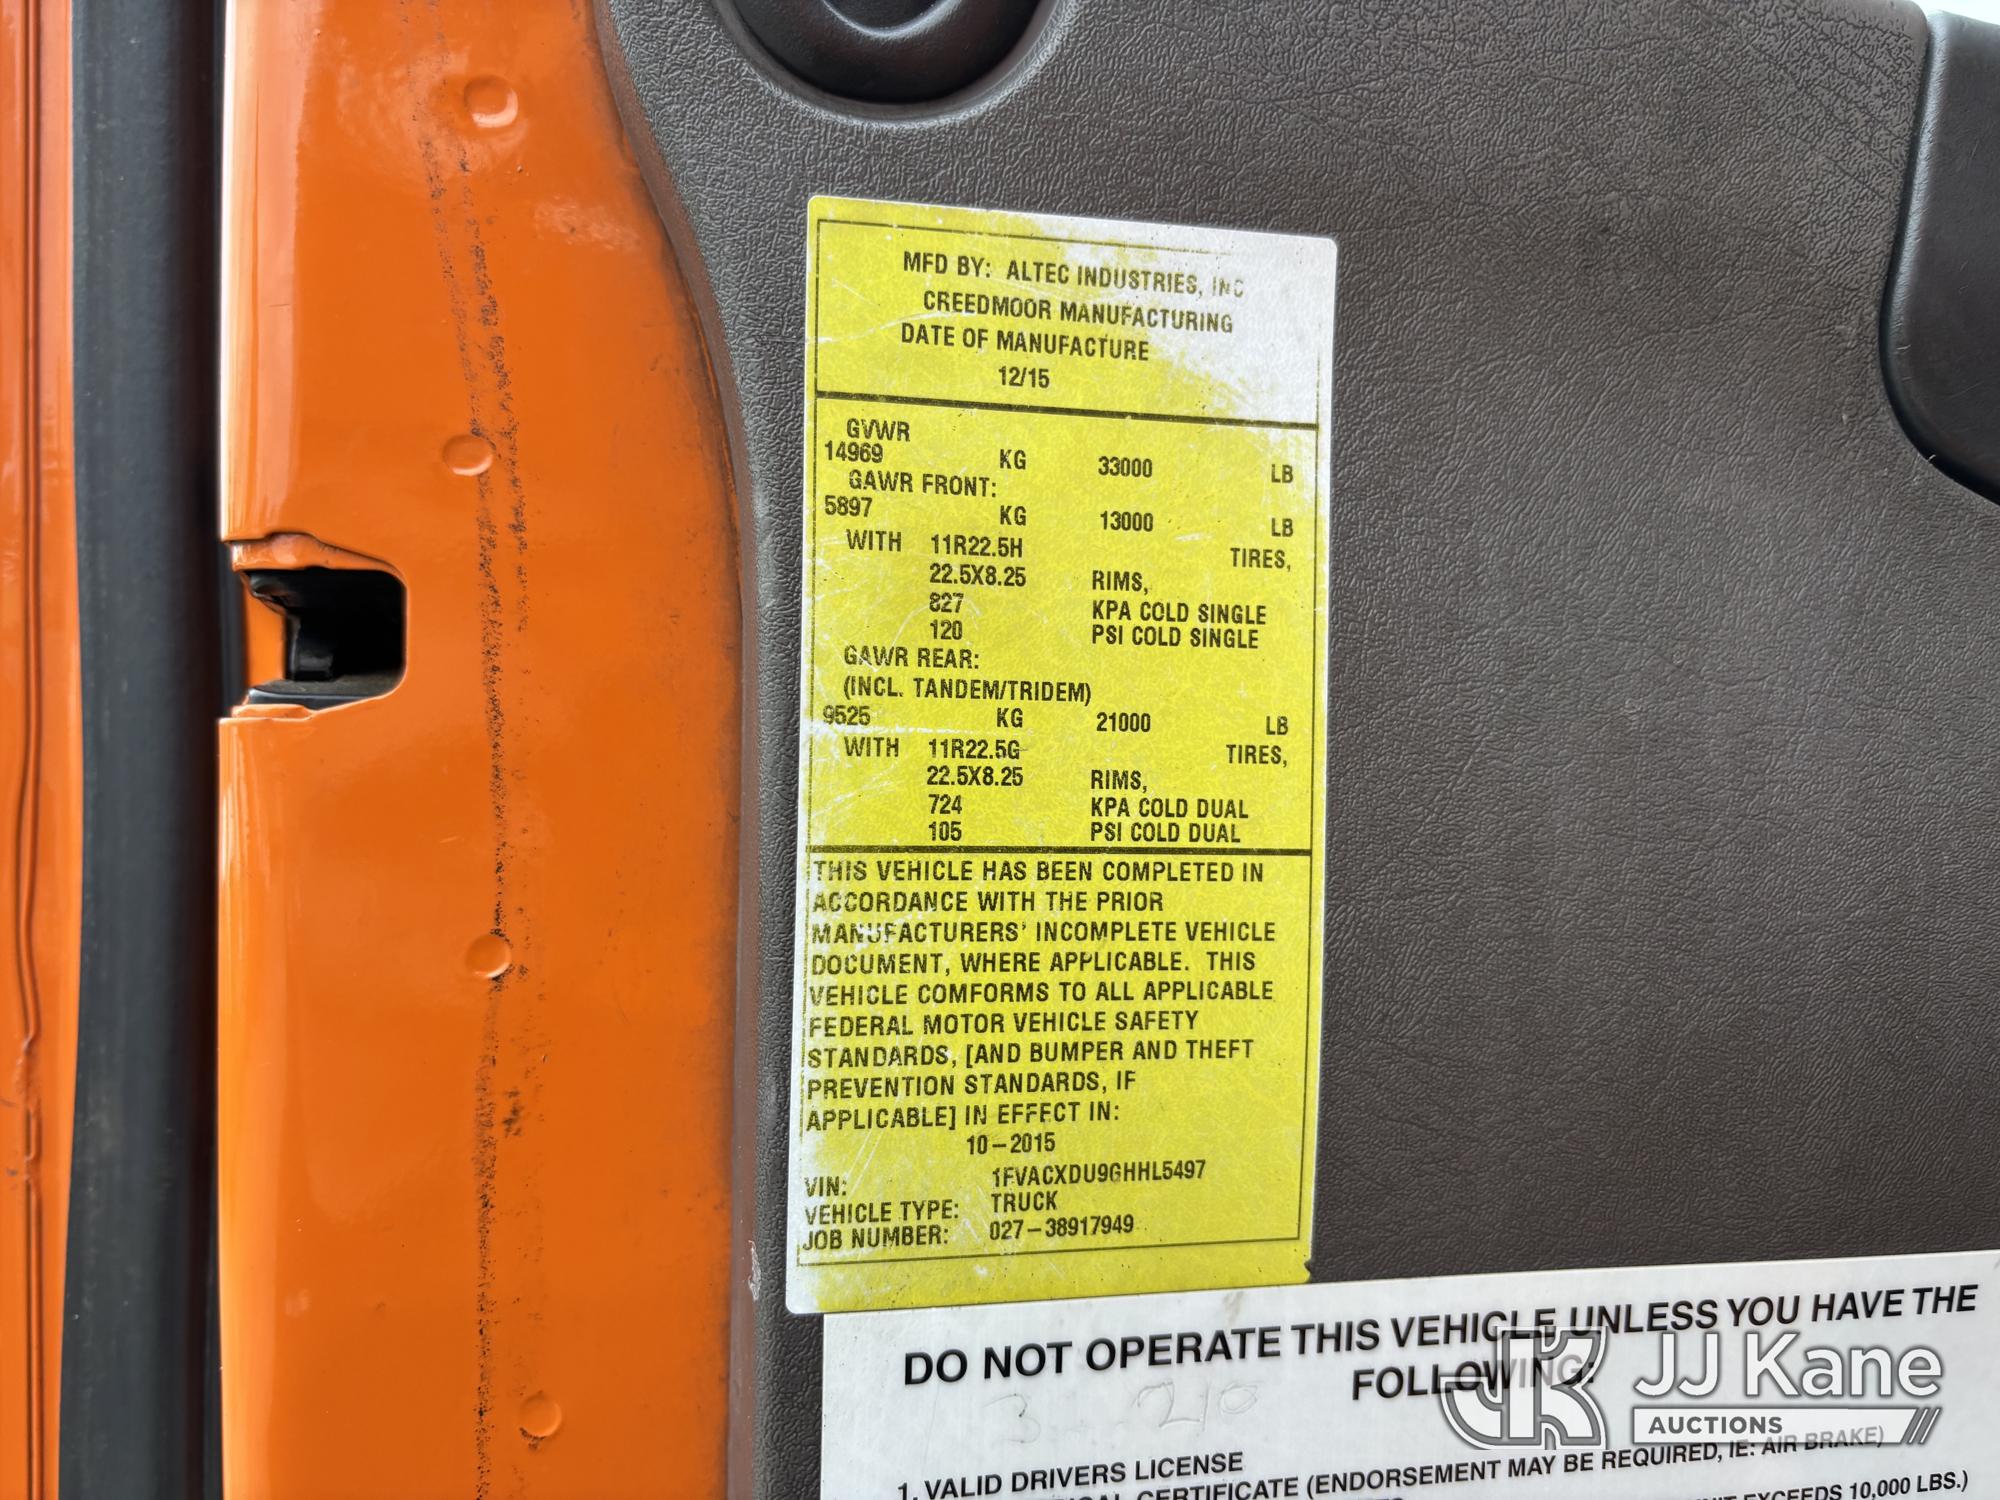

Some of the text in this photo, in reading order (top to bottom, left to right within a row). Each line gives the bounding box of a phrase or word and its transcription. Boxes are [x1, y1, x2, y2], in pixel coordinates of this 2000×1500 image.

[904, 251, 947, 274] MFD
[958, 256, 990, 278] BY:
[1007, 260, 1069, 284] ALTEC
[1078, 266, 1202, 296] INDUSTRIES,
[924, 290, 1232, 333] CREEDMOOR MANUFACTURING
[902, 322, 1148, 361] DATE OF MANUFACTURE
[999, 366, 1049, 388] 12/15
[847, 418, 910, 442] GVWR
[825, 440, 1293, 483] 14969 KG 33000 LB
[849, 469, 996, 497] GAWR FRONT:
[825, 495, 1293, 537] 5897 KG 13000 LB
[846, 529, 1290, 572] WITH 11R22.5H TIRES,
[930, 563, 1148, 595] 22.5X8.25 RIMS,
[929, 592, 1266, 625] 827 KPA COLD SINGLE
[930, 619, 1258, 649] 120 PSI COLD SINGLE
[844, 645, 979, 669] GAWR REAR:
[844, 676, 1091, 706] (INCL. TANDEM/TRIDEM)
[823, 705, 1288, 735] 9525 KG 21000 LB
[844, 736, 1287, 768] WITH 11R22.5G TIRES,
[927, 765, 1147, 793] 22.5X8.25 RIMS,
[928, 794, 1248, 818] 724 KPA COLD DUAL
[929, 821, 1240, 843] 105 PSI COLD DUAL
[814, 860, 1263, 882] THIS VEHICLE HAS BEEN COMPLETED IN
[813, 891, 1163, 912] ACCORDANCE WITH THE PRIOR
[1037, 921, 1176, 941] INCOMPLETE
[1185, 922, 1275, 941] VEHICLE
[812, 951, 1255, 976] DOCUMENT, WHERE APPLICABLE. THIS
[810, 981, 1273, 1006] VEHICLE COMFORMS TO ALL APPLICABLE
[810, 1010, 1198, 1037] FEDERAL MOTOR VEHICLE SAFETY
[808, 1039, 1254, 1068] STANDARDS, [AND BUMPER AND THEFT
[808, 1070, 1135, 1099] PREVENTION STANDARDS, IF
[806, 1101, 1119, 1131] APPLICABLE] IN EFFECT IN:
[805, 1159, 1206, 1197] VIN: 1FVACXDU9GHHL5497
[805, 1190, 1058, 1225] VEHICLE TYPE: TRUCK
[803, 1229, 842, 1250] JOB
[852, 1224, 948, 1248] NUMBER:
[905, 1284, 1979, 1386] DO NOT OPERATE THIS VEHICLE UNLESS YOU HAVE THE
[924, 1474, 1002, 1500] VALID
[1012, 1462, 1126, 1492] DRIVERS
[1136, 1451, 1243, 1480] LICENSE
[1307, 1460, 1501, 1500] (ENDORSEMENT
[1508, 1455, 1556, 1478] MAY
[1564, 1452, 1593, 1473] BE
[1602, 1442, 1722, 1470] REQUIRED,
[1729, 1439, 1754, 1456] IE:
[1762, 1435, 1797, 1455] AIR
[1804, 1429, 1885, 1450] BRAKE)
[1850, 1477, 1910, 1500] 10,000
[1917, 1470, 1968, 1492] LBS.)
